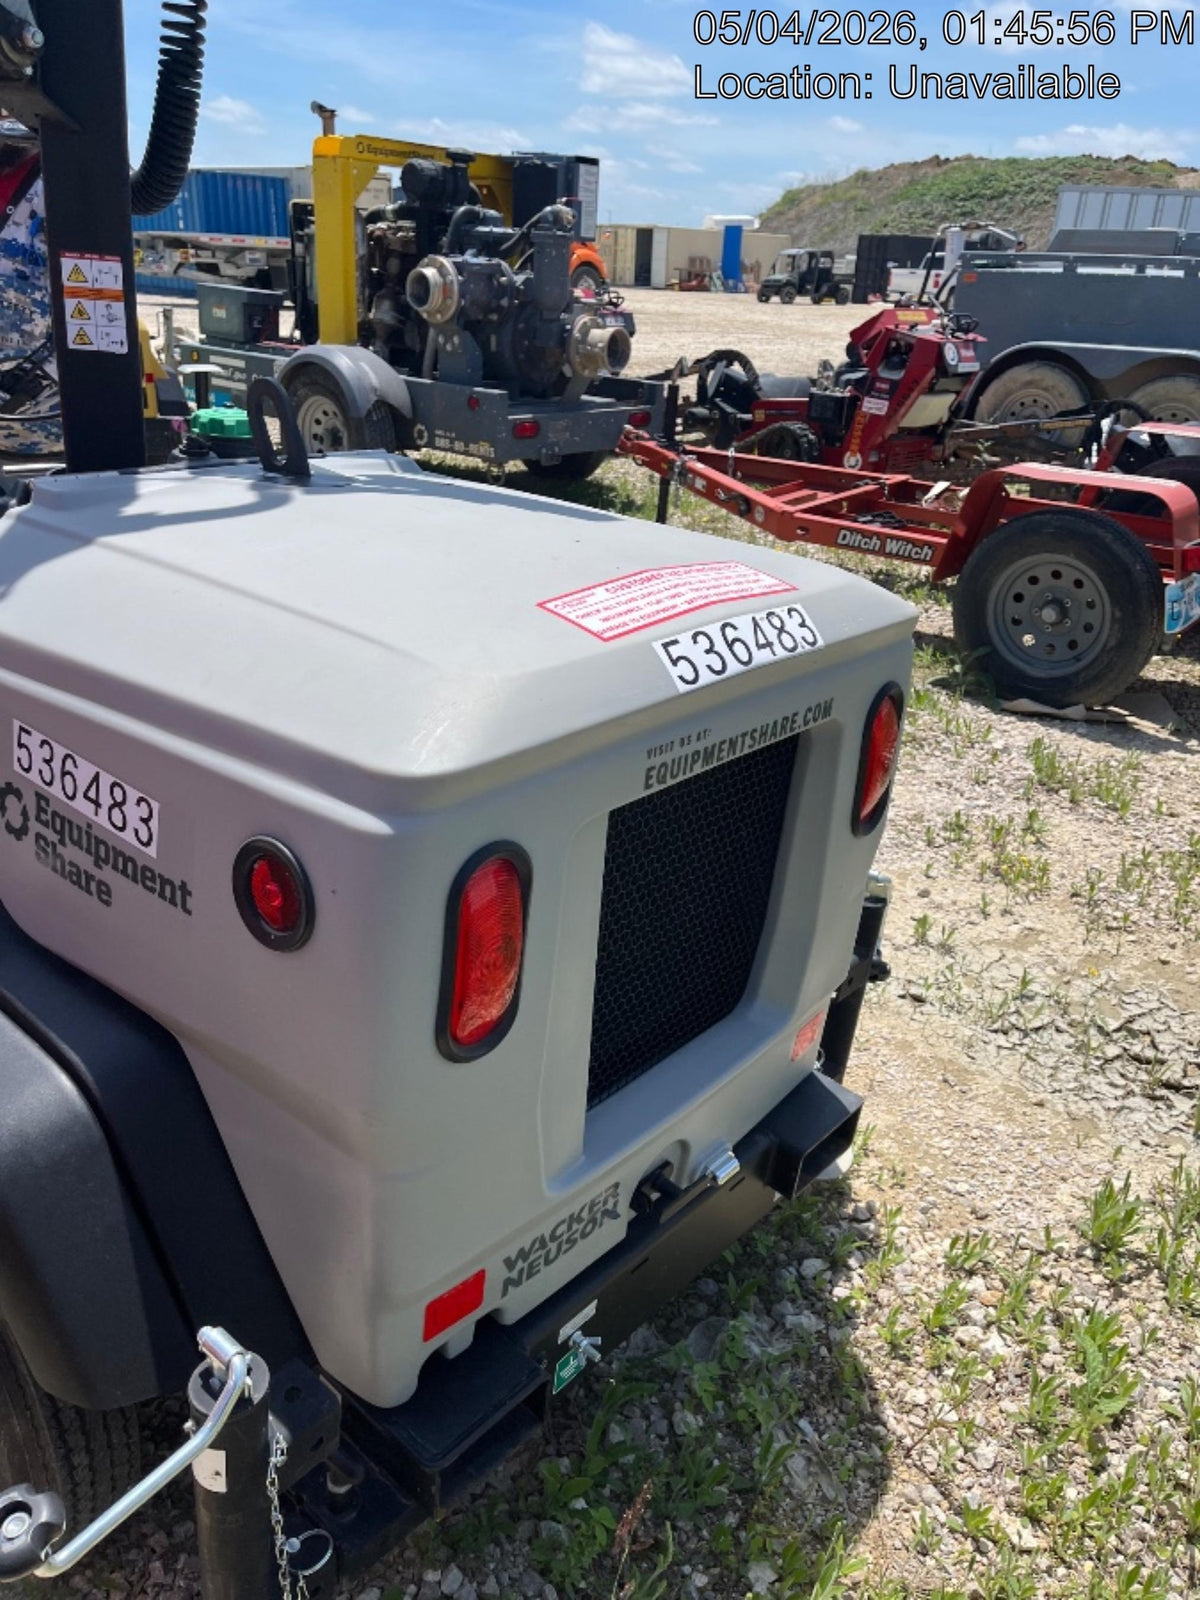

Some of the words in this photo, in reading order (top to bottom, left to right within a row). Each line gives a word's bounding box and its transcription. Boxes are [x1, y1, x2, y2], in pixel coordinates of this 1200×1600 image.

[836, 528, 881, 551] Ditch
[884, 538, 934, 561] Witch
[661, 606, 819, 686] 536483
[16, 724, 154, 849] 536483
[643, 697, 835, 791] EQUIPMENTSHARE.COM
[646, 740, 675, 759] VISIT
[34, 790, 193, 916] Equipment
[34, 830, 113, 908] Share
[501, 1199, 621, 1299] NEUSON
[502, 1181, 621, 1273] WACKER
